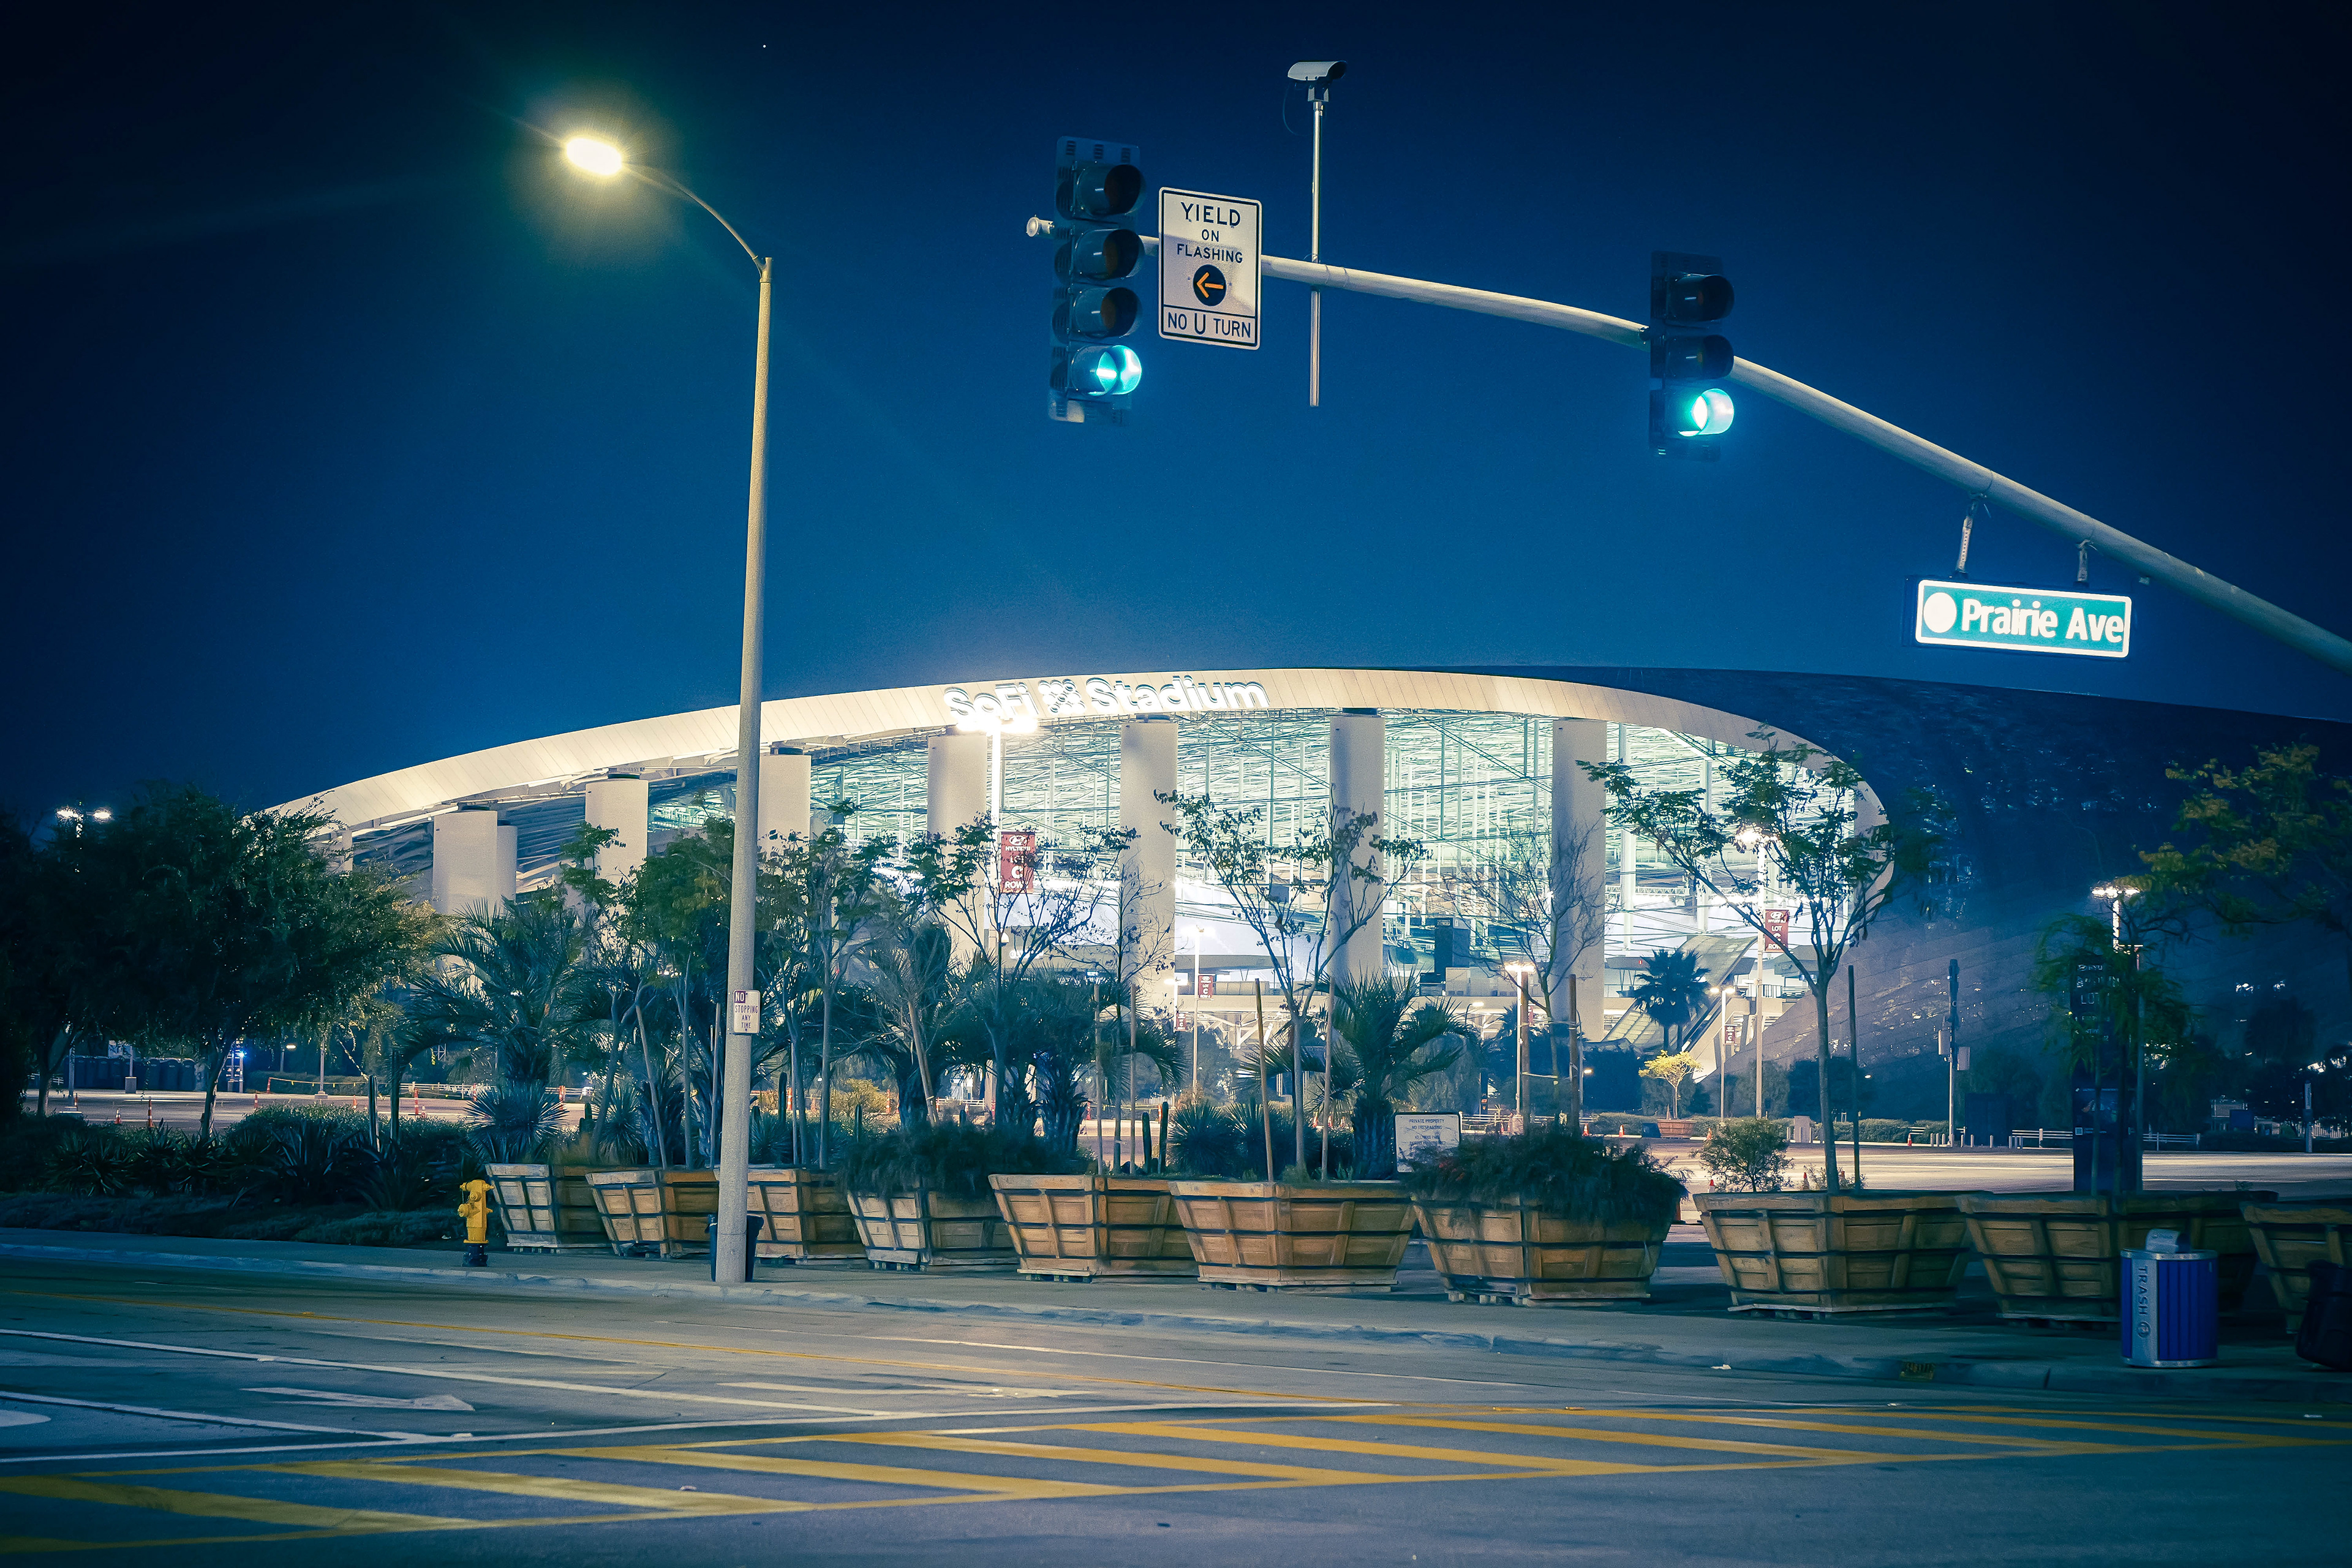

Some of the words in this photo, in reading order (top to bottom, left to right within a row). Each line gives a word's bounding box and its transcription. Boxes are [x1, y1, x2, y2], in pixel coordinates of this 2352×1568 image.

[1181, 202, 1241, 227] YIELD
[1201, 229, 1219, 242] ON
[1177, 243, 1243, 263] FLASHING
[1168, 312, 1187, 330] NO
[1194, 313, 1206, 334] U
[1213, 318, 1251, 337] TURN
[1961, 598, 2059, 638] Prairie
[2065, 607, 2124, 643] Ave
[944, 682, 1039, 722] SoFi
[1086, 674, 1270, 712] Stadium
[1011, 865, 1023, 879] C
[735, 992, 745, 1001] NO
[734, 1005, 758, 1014] STOPPING
[2138, 1265, 2149, 1316] TRASH
